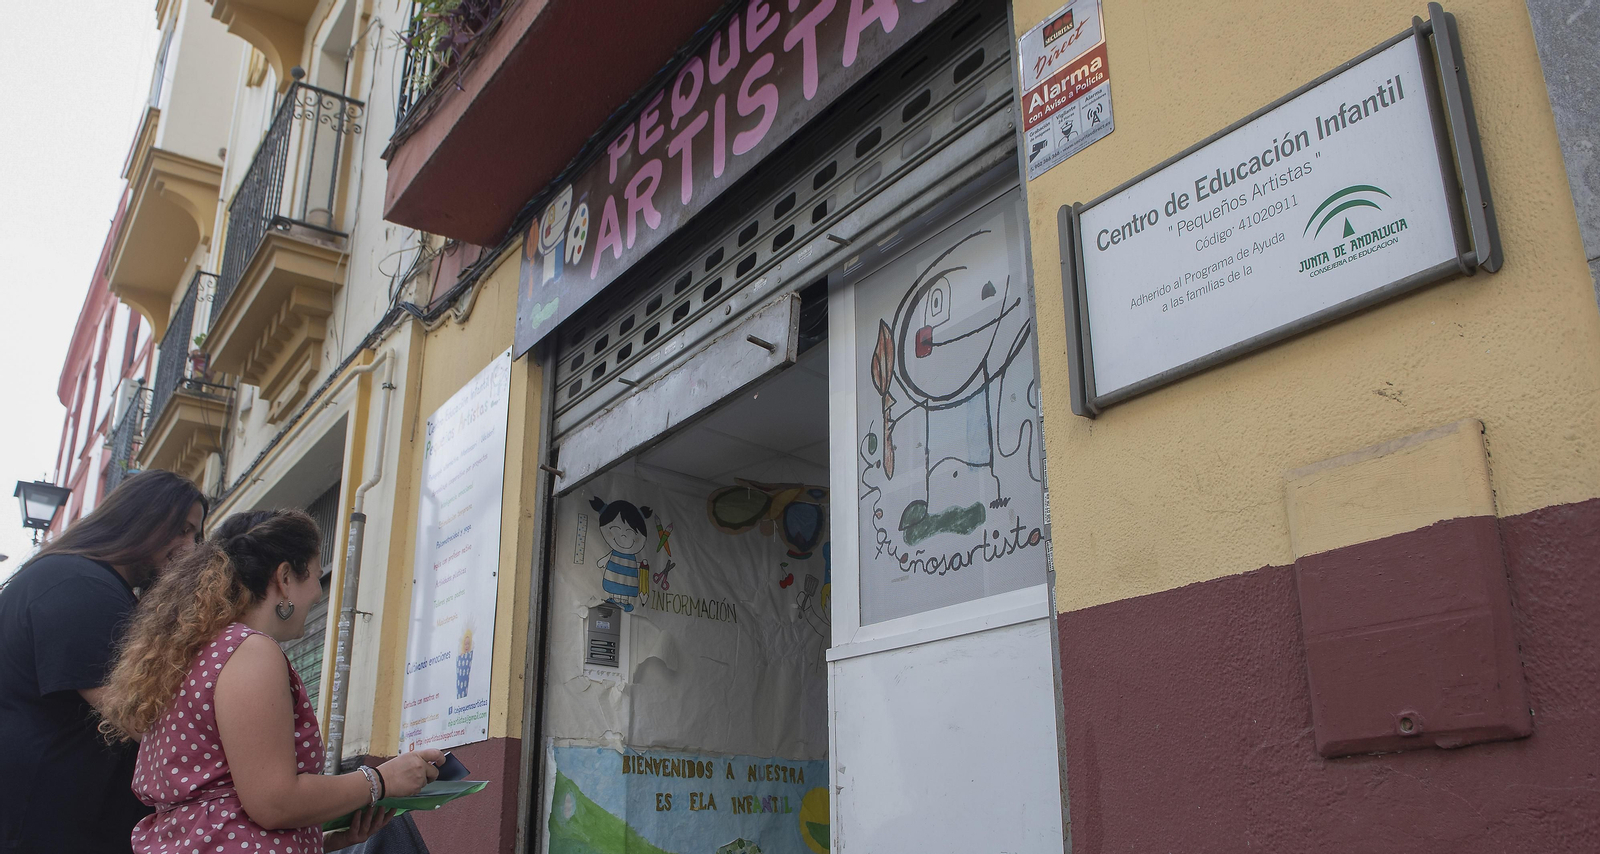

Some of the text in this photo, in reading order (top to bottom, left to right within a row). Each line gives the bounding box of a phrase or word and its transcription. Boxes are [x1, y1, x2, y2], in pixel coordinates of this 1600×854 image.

[1033, 17, 1090, 79] Direct
[1045, 23, 1073, 45] SECURITAS
[1028, 56, 1102, 114] Alarma
[1028, 112, 1043, 124] con
[1044, 96, 1066, 115] Aviso
[1068, 91, 1074, 99] a
[1075, 72, 1104, 94] Policía
[590, 0, 928, 279] ARTISTA
[1097, 75, 1405, 251] Centro de Educación Infantil
[1238, 194, 1299, 232] 41020911
[1130, 231, 1286, 310] Adherido al Programa de Ayuda
[1299, 251, 1330, 273] JUNTA
[1333, 243, 1347, 258] DE
[1309, 236, 1399, 278] CONSEJERIA DE EDUCACION
[1162, 265, 1253, 312] a las familias de la
[458, 399, 488, 433] Artistas
[651, 590, 738, 624] INFORMACIÓN
[622, 755, 805, 784] BIENVENIDOS A NUESTRA
[731, 794, 793, 815] INFANTIL
